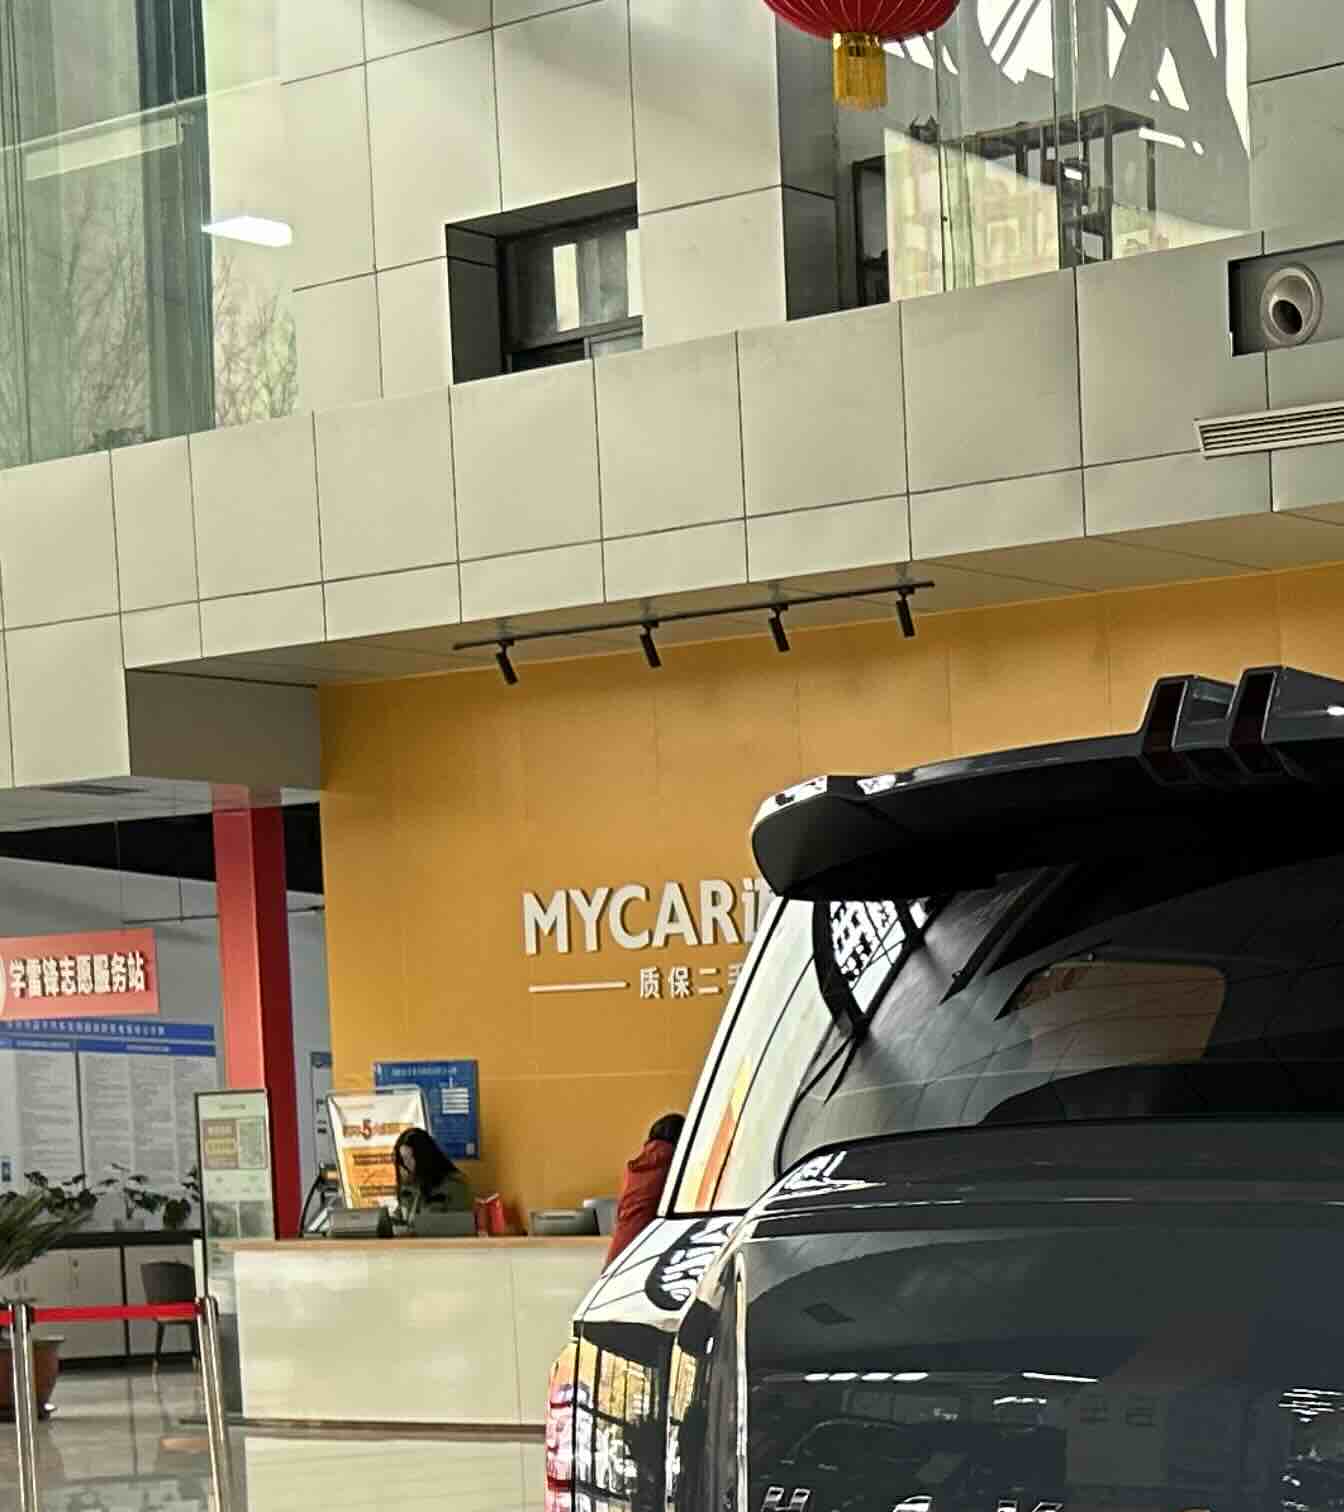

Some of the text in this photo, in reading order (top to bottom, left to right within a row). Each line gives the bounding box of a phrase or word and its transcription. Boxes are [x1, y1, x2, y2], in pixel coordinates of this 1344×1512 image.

[9, 950, 146, 998] 学雷锋志愿服务站
